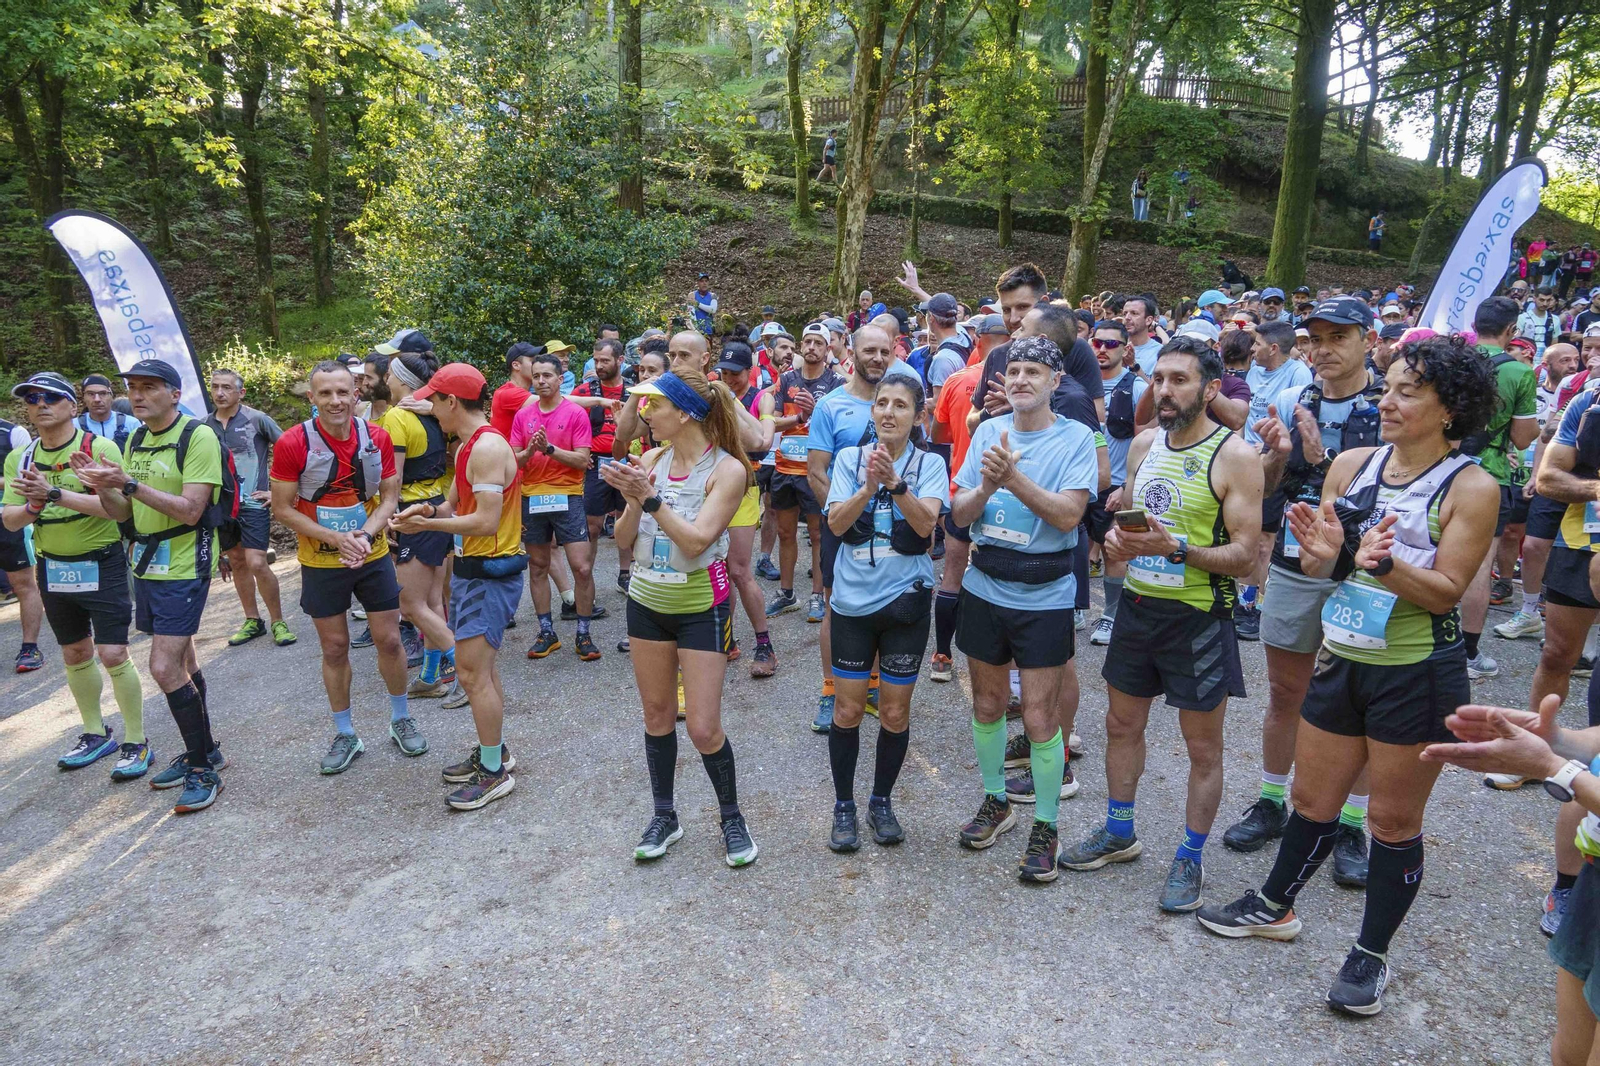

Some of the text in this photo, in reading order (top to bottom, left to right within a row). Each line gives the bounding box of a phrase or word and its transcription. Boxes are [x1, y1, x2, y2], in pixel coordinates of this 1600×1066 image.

[789, 445, 806, 454] 234
[539, 495, 557, 504] 182
[995, 509, 1006, 524] 6
[331, 519, 358, 532] 349
[1136, 555, 1167, 570] 454
[59, 570, 82, 583] 281
[1331, 603, 1365, 630] 283
